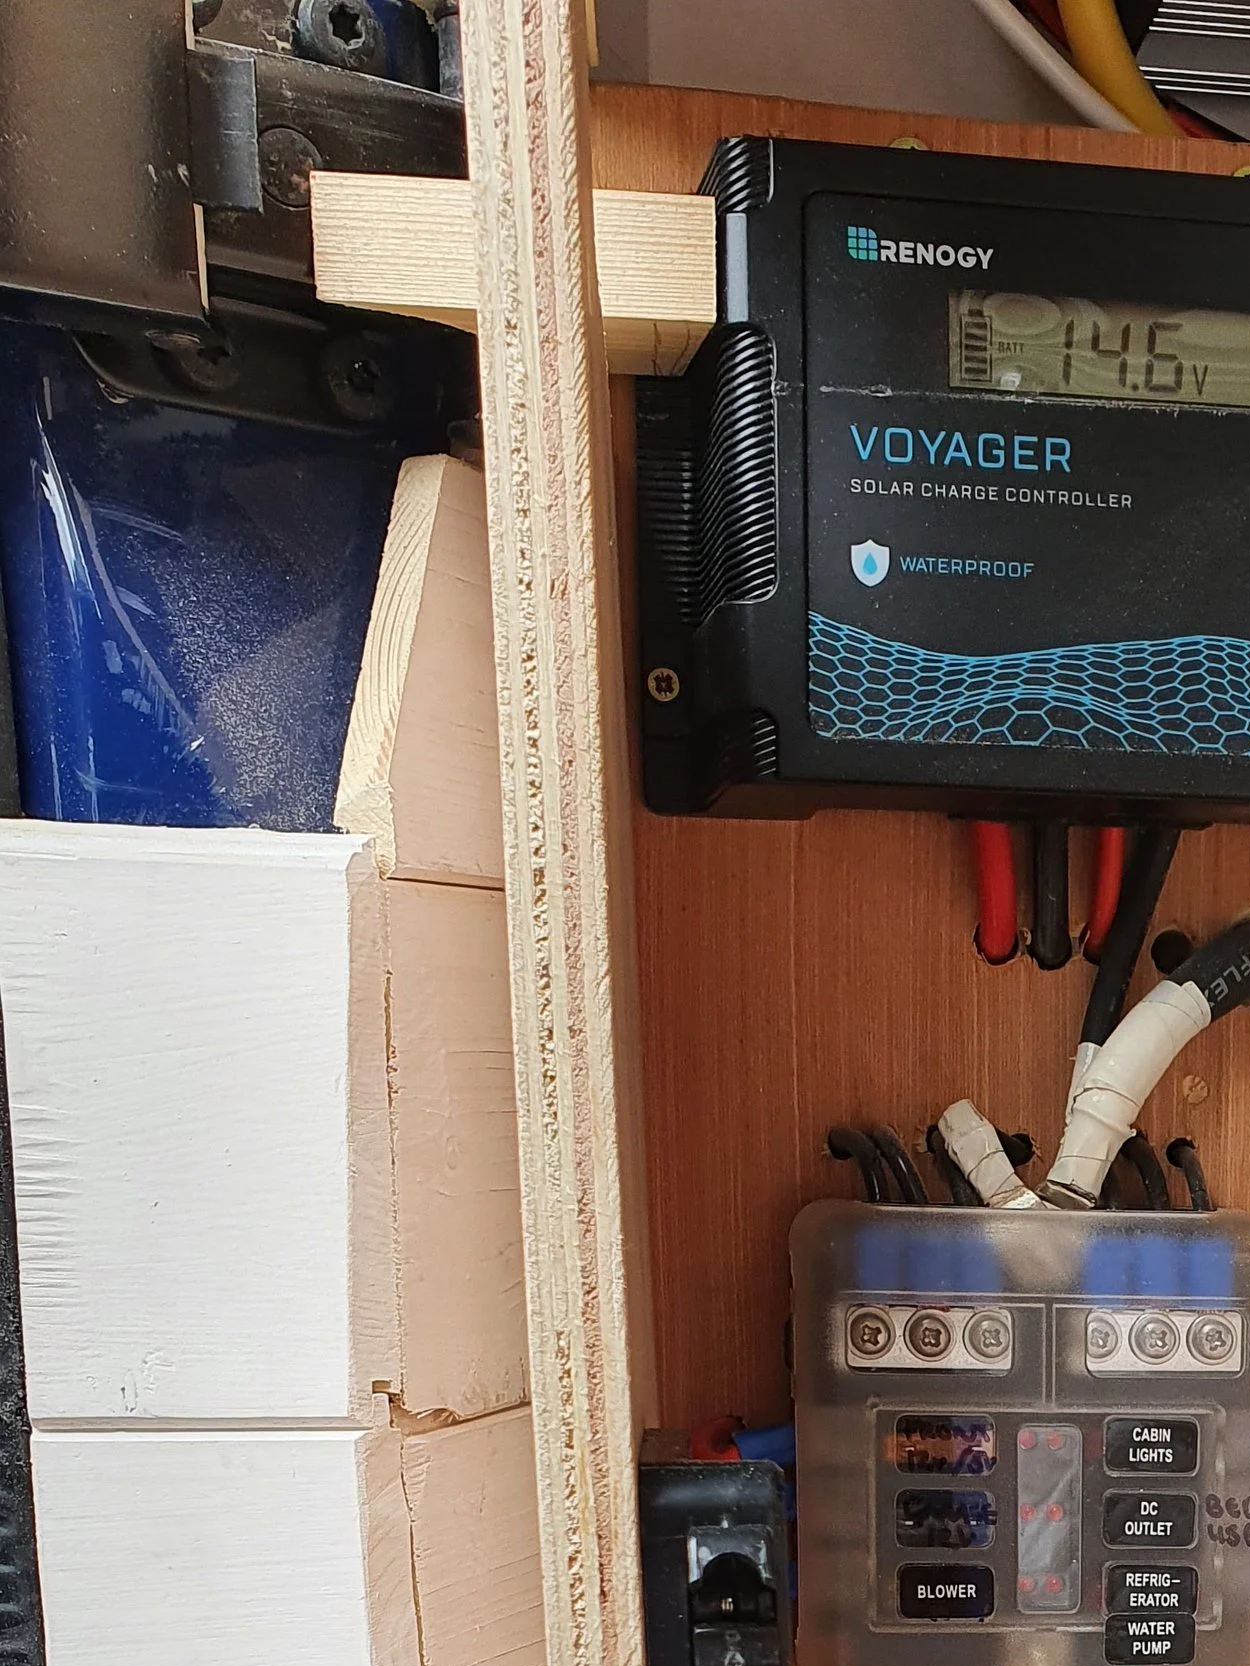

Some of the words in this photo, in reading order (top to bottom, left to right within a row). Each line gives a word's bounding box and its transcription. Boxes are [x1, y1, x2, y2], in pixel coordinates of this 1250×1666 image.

[880, 240, 993, 269] RENOGY
[1062, 317, 1184, 393] 14.6
[1192, 363, 1209, 396] V
[849, 425, 1072, 472] VOYAGER
[850, 478, 914, 498] SOLAR
[920, 482, 1001, 502] CHARGE
[1005, 486, 1133, 508] CONTROLLER
[899, 555, 1035, 579] WATERPROOF
[1132, 1426, 1171, 1444] CABIN
[1128, 1446, 1173, 1464] LIGHTS
[1139, 1501, 1159, 1517] DC
[1124, 1520, 1173, 1537] OUTLET
[917, 1583, 976, 1600] BLOWER
[1128, 1592, 1179, 1608] ERATOR
[1127, 1621, 1175, 1638] WATER
[1132, 1640, 1171, 1656] PUMP
